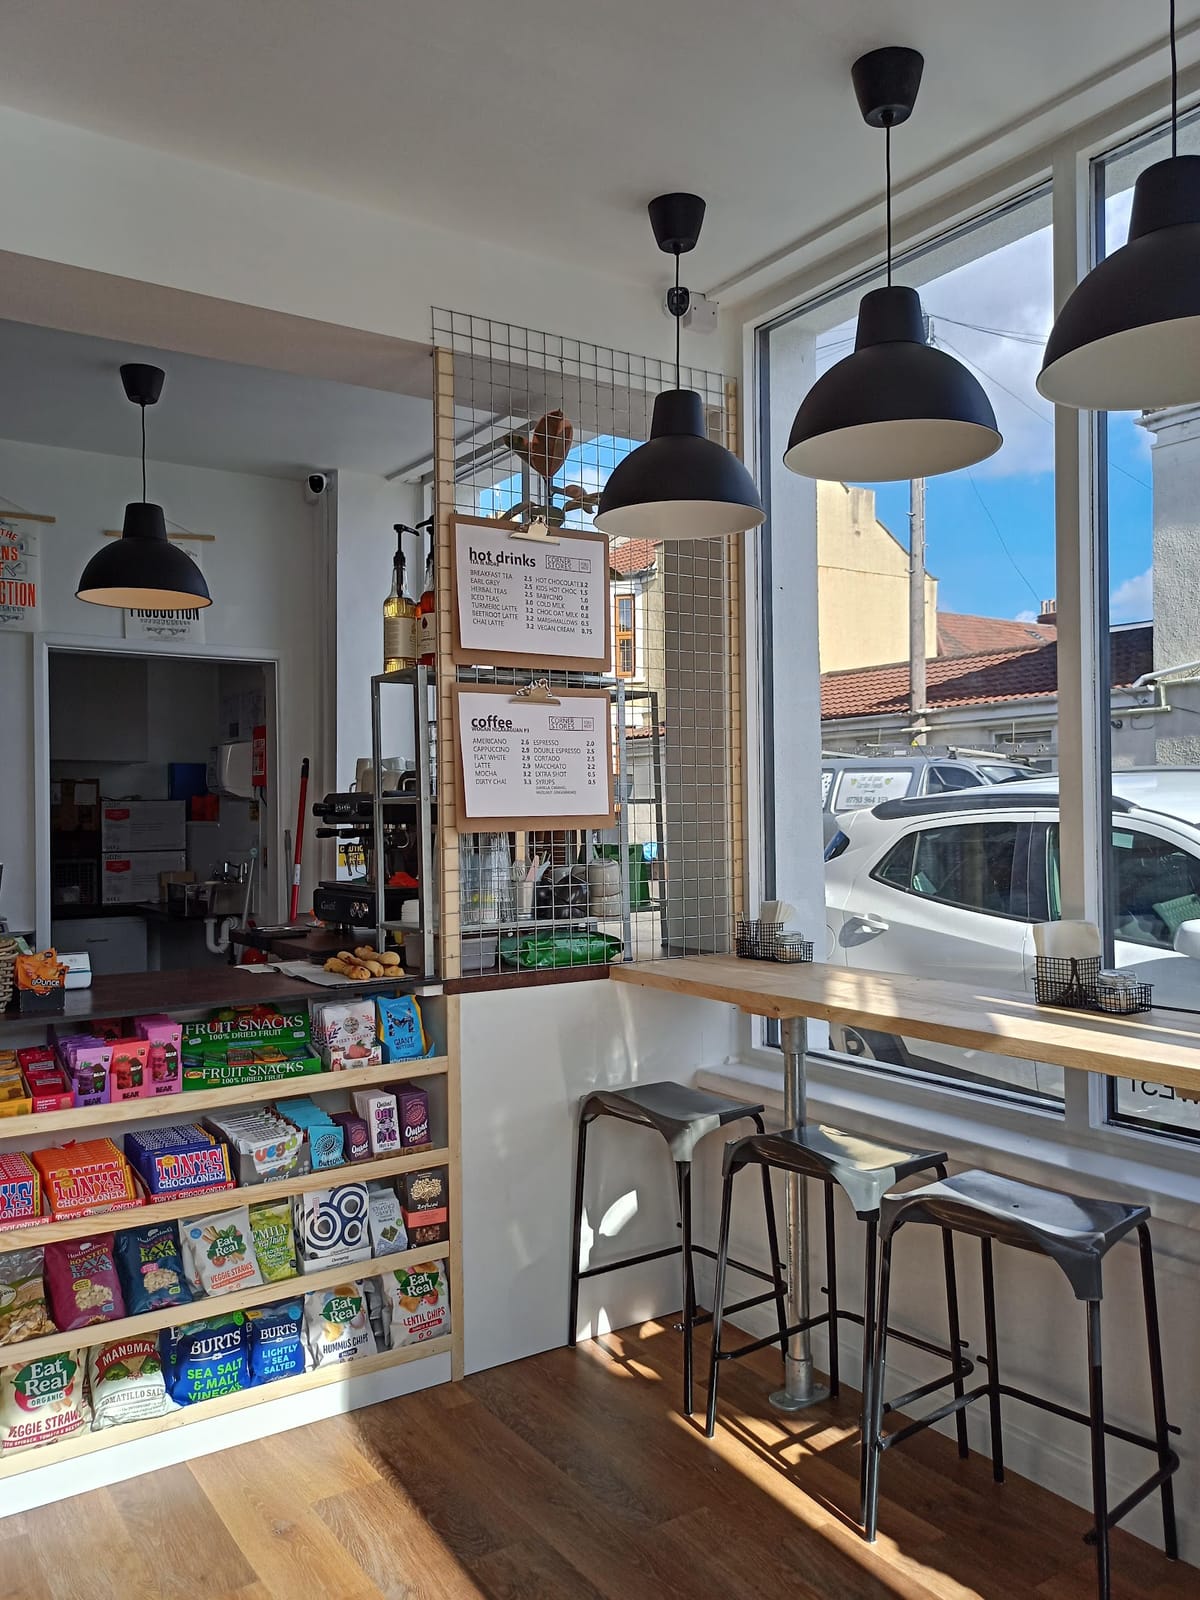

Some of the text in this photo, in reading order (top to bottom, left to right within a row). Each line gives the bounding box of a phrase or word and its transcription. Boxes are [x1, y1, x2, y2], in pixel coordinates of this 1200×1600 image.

[0, 528, 18, 541] THE
[469, 546, 536, 568] hot drinks
[470, 570, 500, 578] BREAKFAST
[471, 586, 492, 594] HERBAL
[548, 578, 580, 588] CHOCOLATE
[472, 602, 500, 610] TURMERIC
[502, 604, 518, 612] LATTE
[472, 610, 501, 618] BEETROOT
[537, 616, 578, 626] MARSHMALLOWS
[471, 714, 512, 728] coffee
[474, 753, 487, 761] FLAT
[185, 1015, 304, 1035] FRUIT SNACKS
[232, 1031, 256, 1039] DRIED
[258, 1028, 282, 1036] FRUIT
[394, 1036, 414, 1046] GIANT
[202, 1066, 244, 1079] FRUIT
[248, 1061, 304, 1076] SNACKS
[122, 1091, 140, 1099] BEAR
[156, 1085, 172, 1093] BEAR
[84, 1097, 102, 1105] BEAR
[252, 1224, 288, 1242] EMILY
[140, 1240, 174, 1255] FAVA
[217, 1236, 234, 1247] Eat
[70, 1247, 108, 1265] ROASTED
[141, 1249, 177, 1262] BEANS
[216, 1242, 239, 1257] Real
[69, 1254, 110, 1273] FAVA
[72, 1262, 112, 1278] BEANS
[210, 1270, 231, 1283] VEGGIE
[230, 1262, 253, 1276] STRAWS
[409, 1272, 430, 1286] Eat
[406, 1282, 433, 1297] Real
[331, 1297, 353, 1311] Eat
[330, 1307, 357, 1322] Real
[403, 1307, 446, 1327] LENTIL CHIPS
[260, 1322, 298, 1340] BURTS
[190, 1330, 241, 1355] BURTS
[323, 1333, 368, 1354] HUMMUS CHIPS
[102, 1342, 154, 1366] MANOMAS
[262, 1344, 298, 1359] LIGHTLY
[264, 1360, 296, 1374] SALTED
[272, 1355, 289, 1364] SEA
[30, 1359, 63, 1380] Eat
[187, 1357, 243, 1379] SEA SALT
[24, 1370, 68, 1396] Real
[194, 1372, 239, 1391] & MALT
[31, 1392, 64, 1406] ORGANIC
[102, 1390, 145, 1406] OMATILLO
[146, 1388, 164, 1397] SAL
[8, 1420, 42, 1438] VEGGIE
